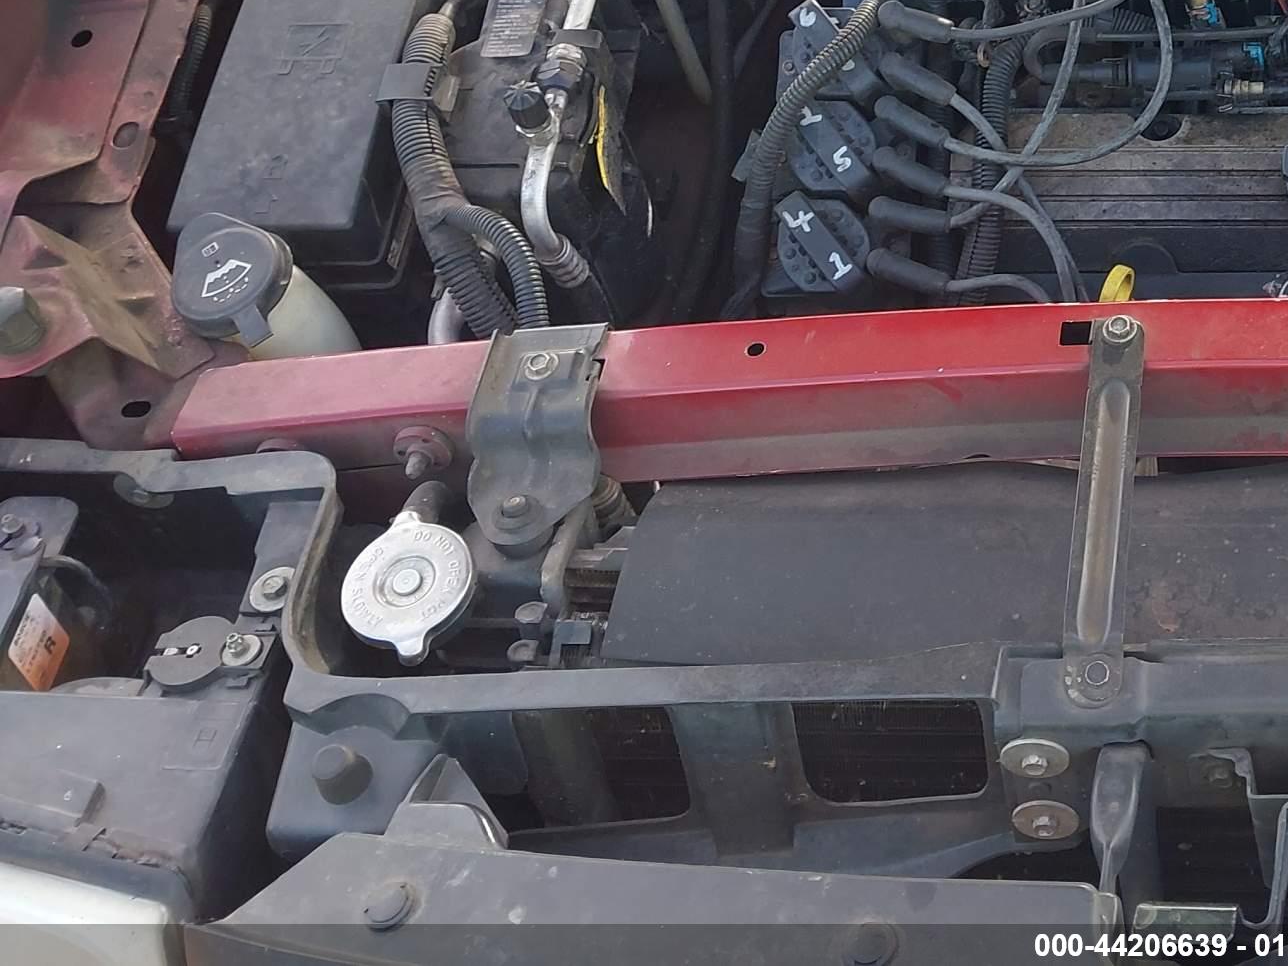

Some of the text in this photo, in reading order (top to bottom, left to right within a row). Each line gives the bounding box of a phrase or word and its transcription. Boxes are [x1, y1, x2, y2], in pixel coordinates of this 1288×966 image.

[833, 146, 851, 172] 5
[782, 210, 815, 232] 4
[829, 251, 853, 280] 1
[414, 530, 433, 543] DO
[433, 535, 455, 556] NOT
[440, 560, 460, 595] OPEN
